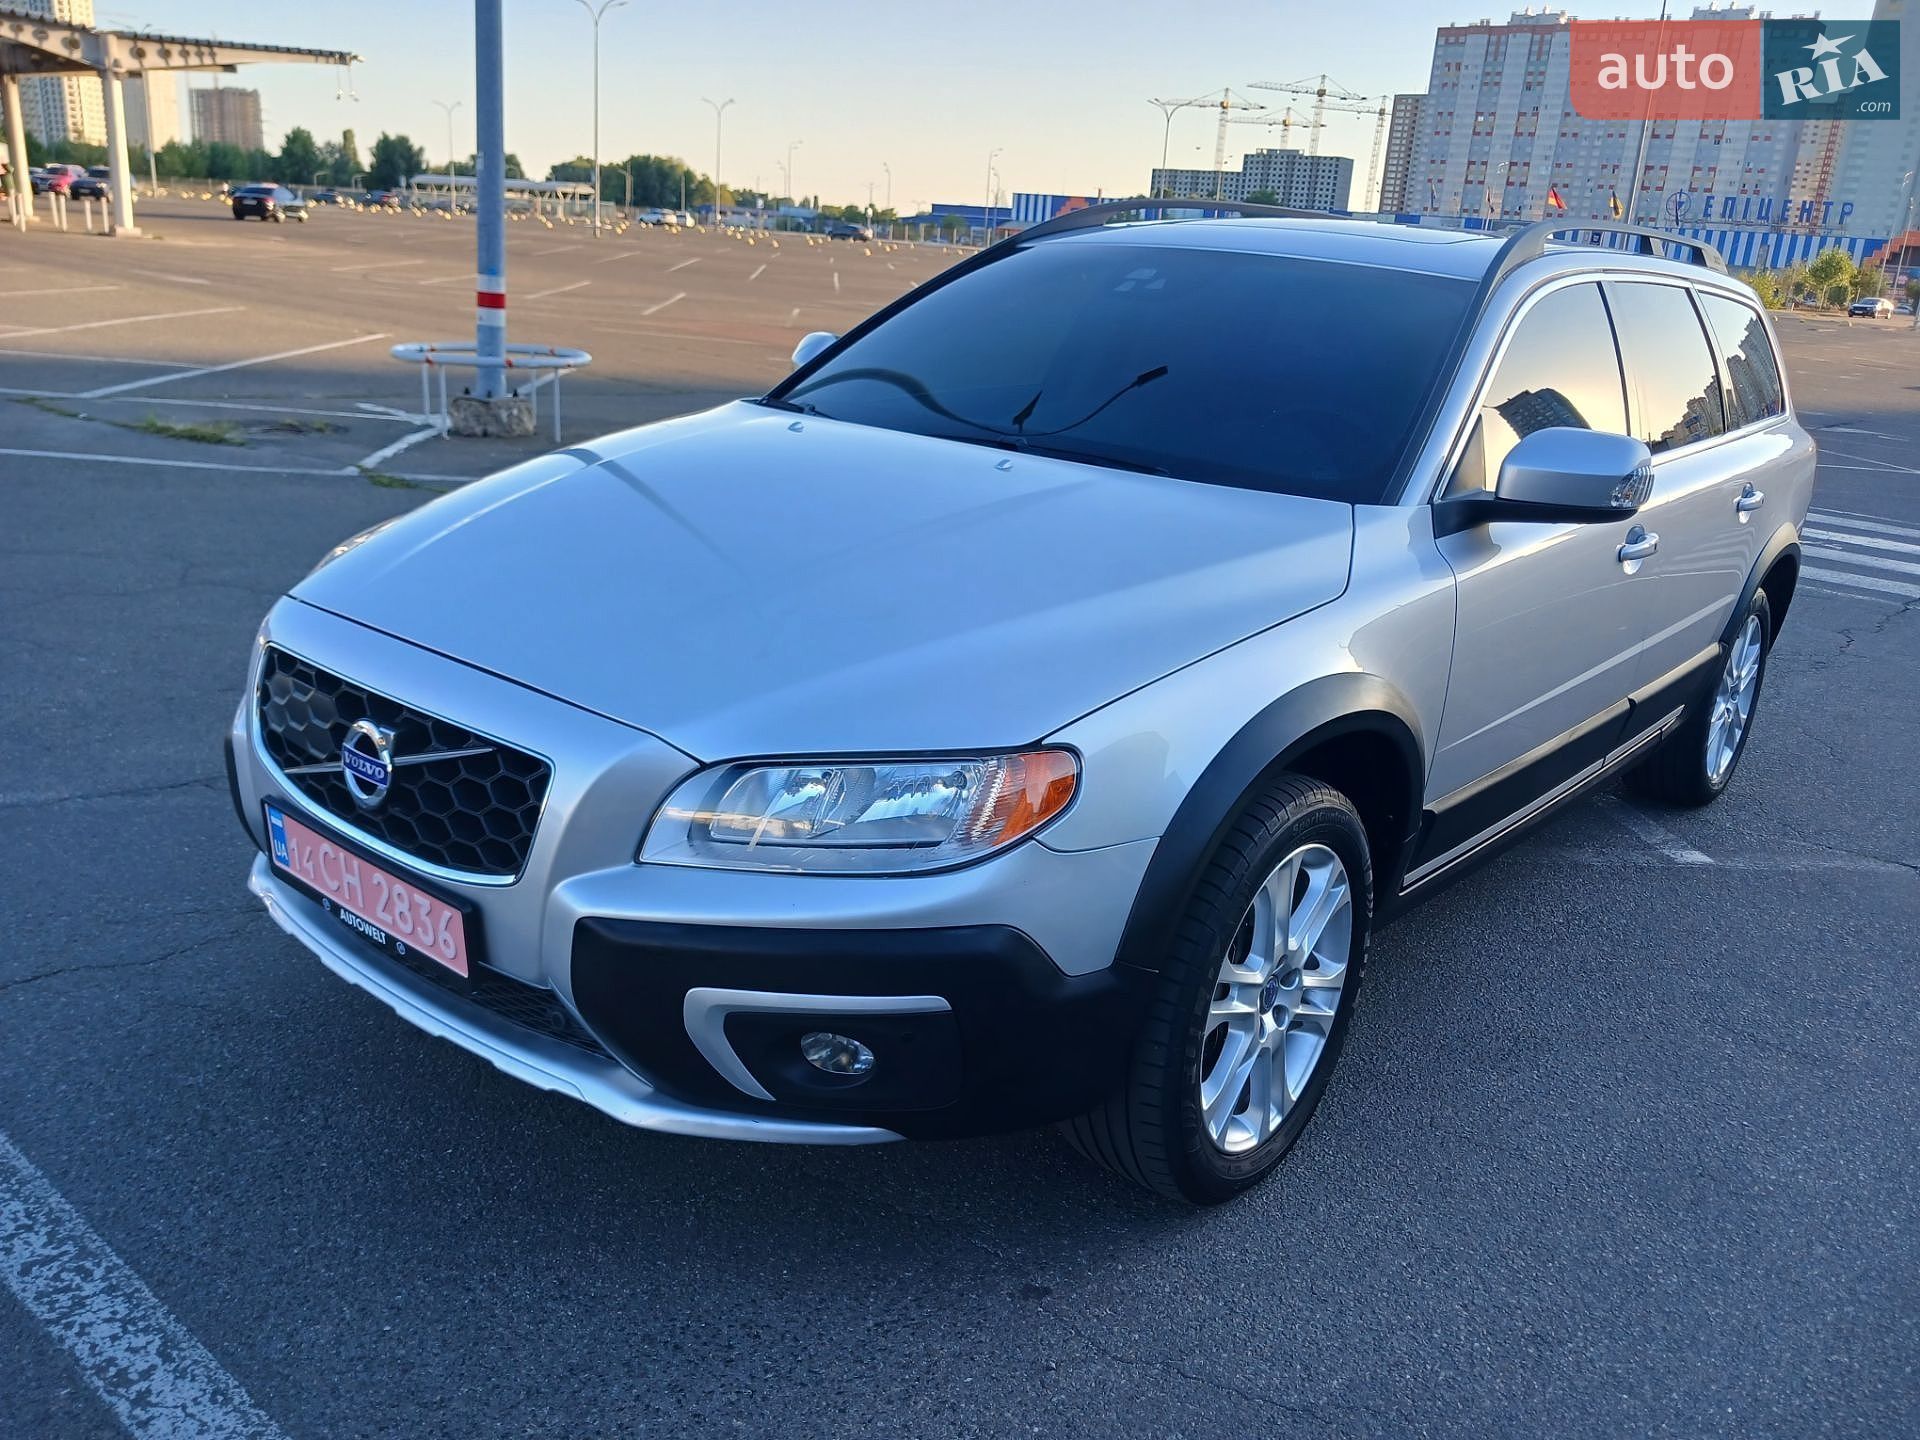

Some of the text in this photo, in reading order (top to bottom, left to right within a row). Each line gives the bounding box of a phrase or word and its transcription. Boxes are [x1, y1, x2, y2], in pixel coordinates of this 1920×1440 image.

[1702, 194, 1855, 226] ЕПІЦЕНТР
[343, 750, 386, 780] VOLVO
[273, 839, 290, 861] UA
[340, 907, 387, 945] AUTOWELT
[372, 872, 458, 961] 2836
